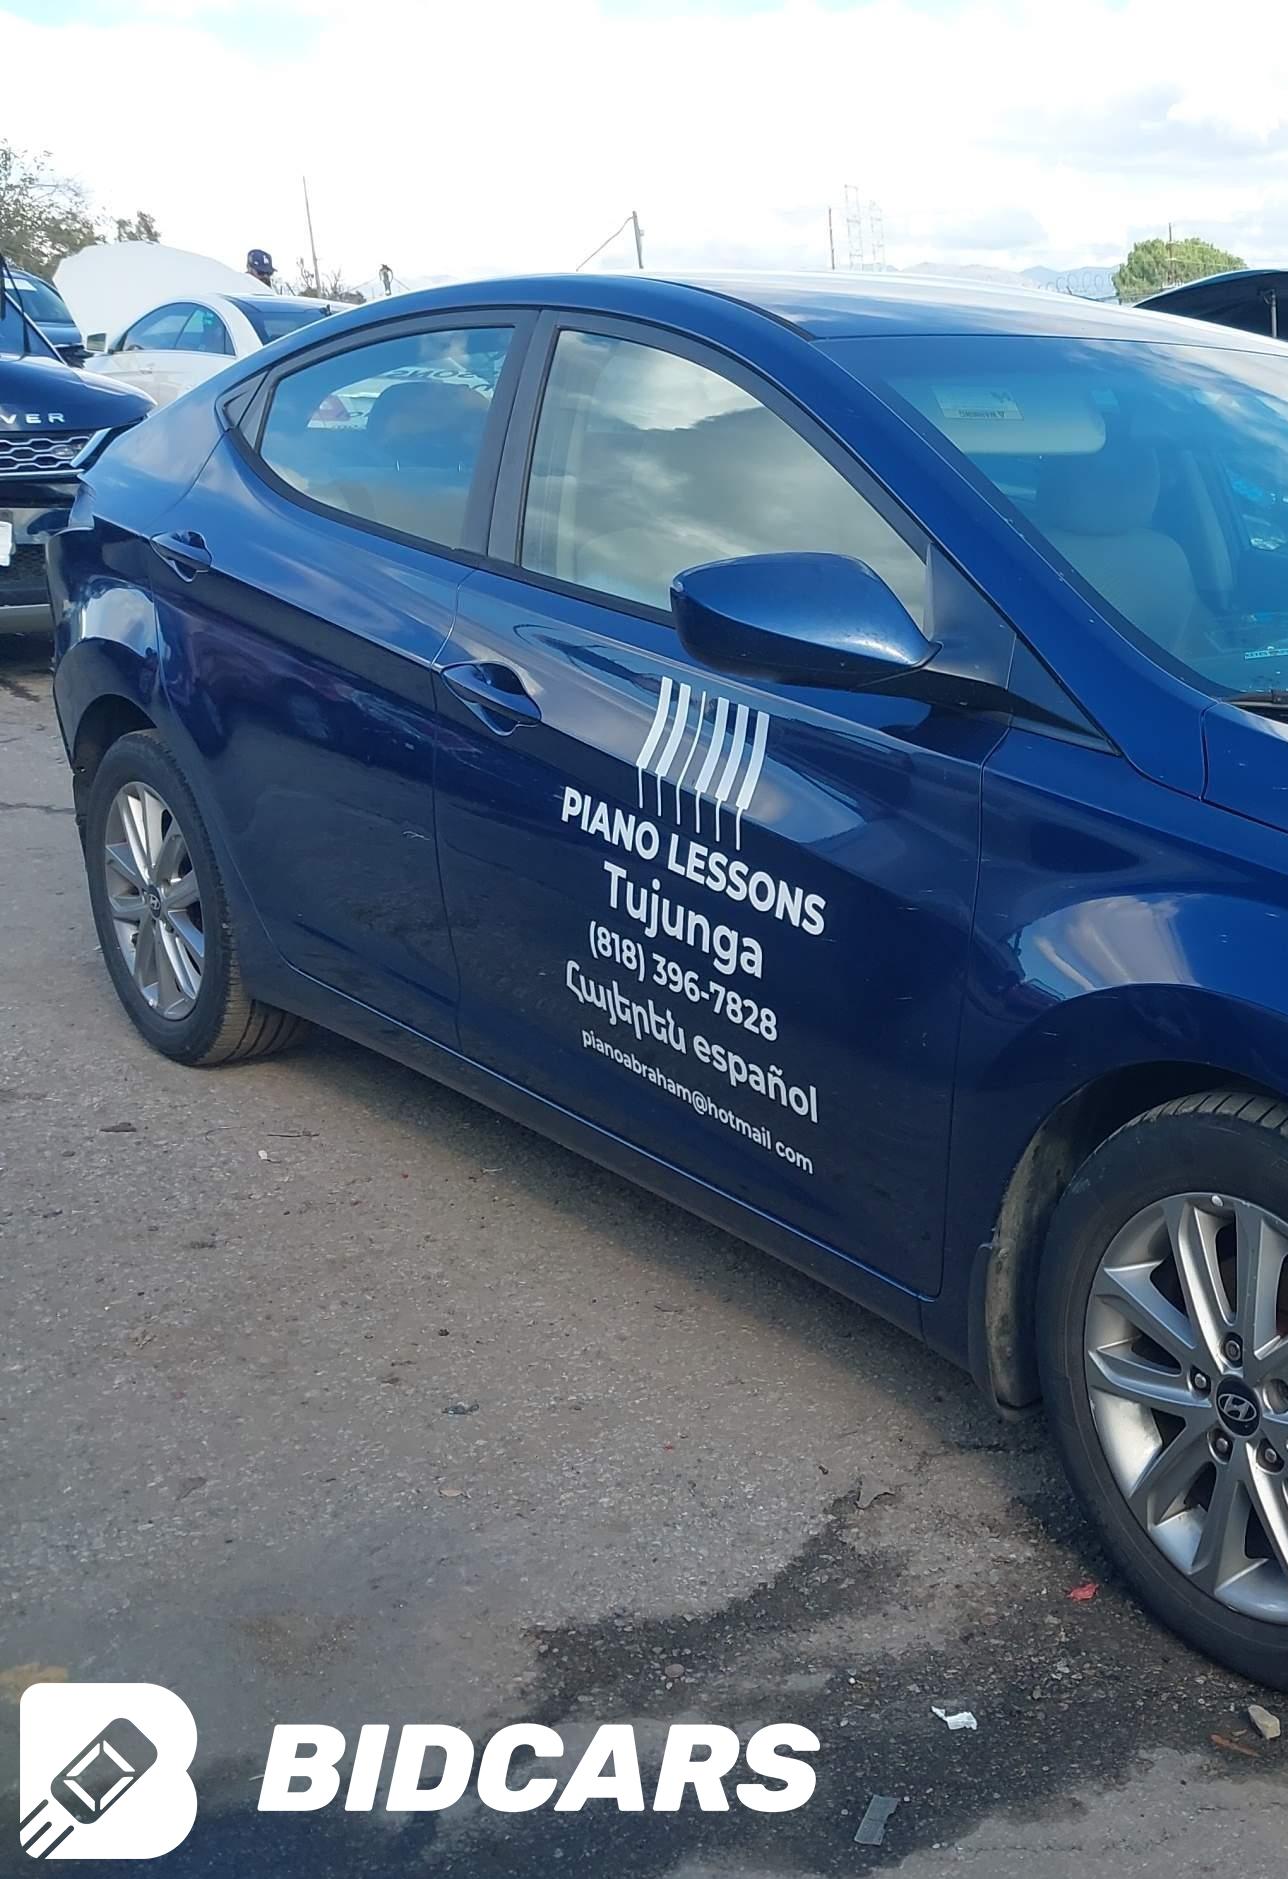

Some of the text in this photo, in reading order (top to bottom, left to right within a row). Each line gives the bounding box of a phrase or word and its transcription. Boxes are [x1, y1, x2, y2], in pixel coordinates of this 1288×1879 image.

[561, 786, 827, 936] PIANO LESSONS
[603, 860, 763, 979] Tujunga
[566, 960, 819, 1123] Հայերեն español
[589, 920, 778, 1041] (818) 396-7828
